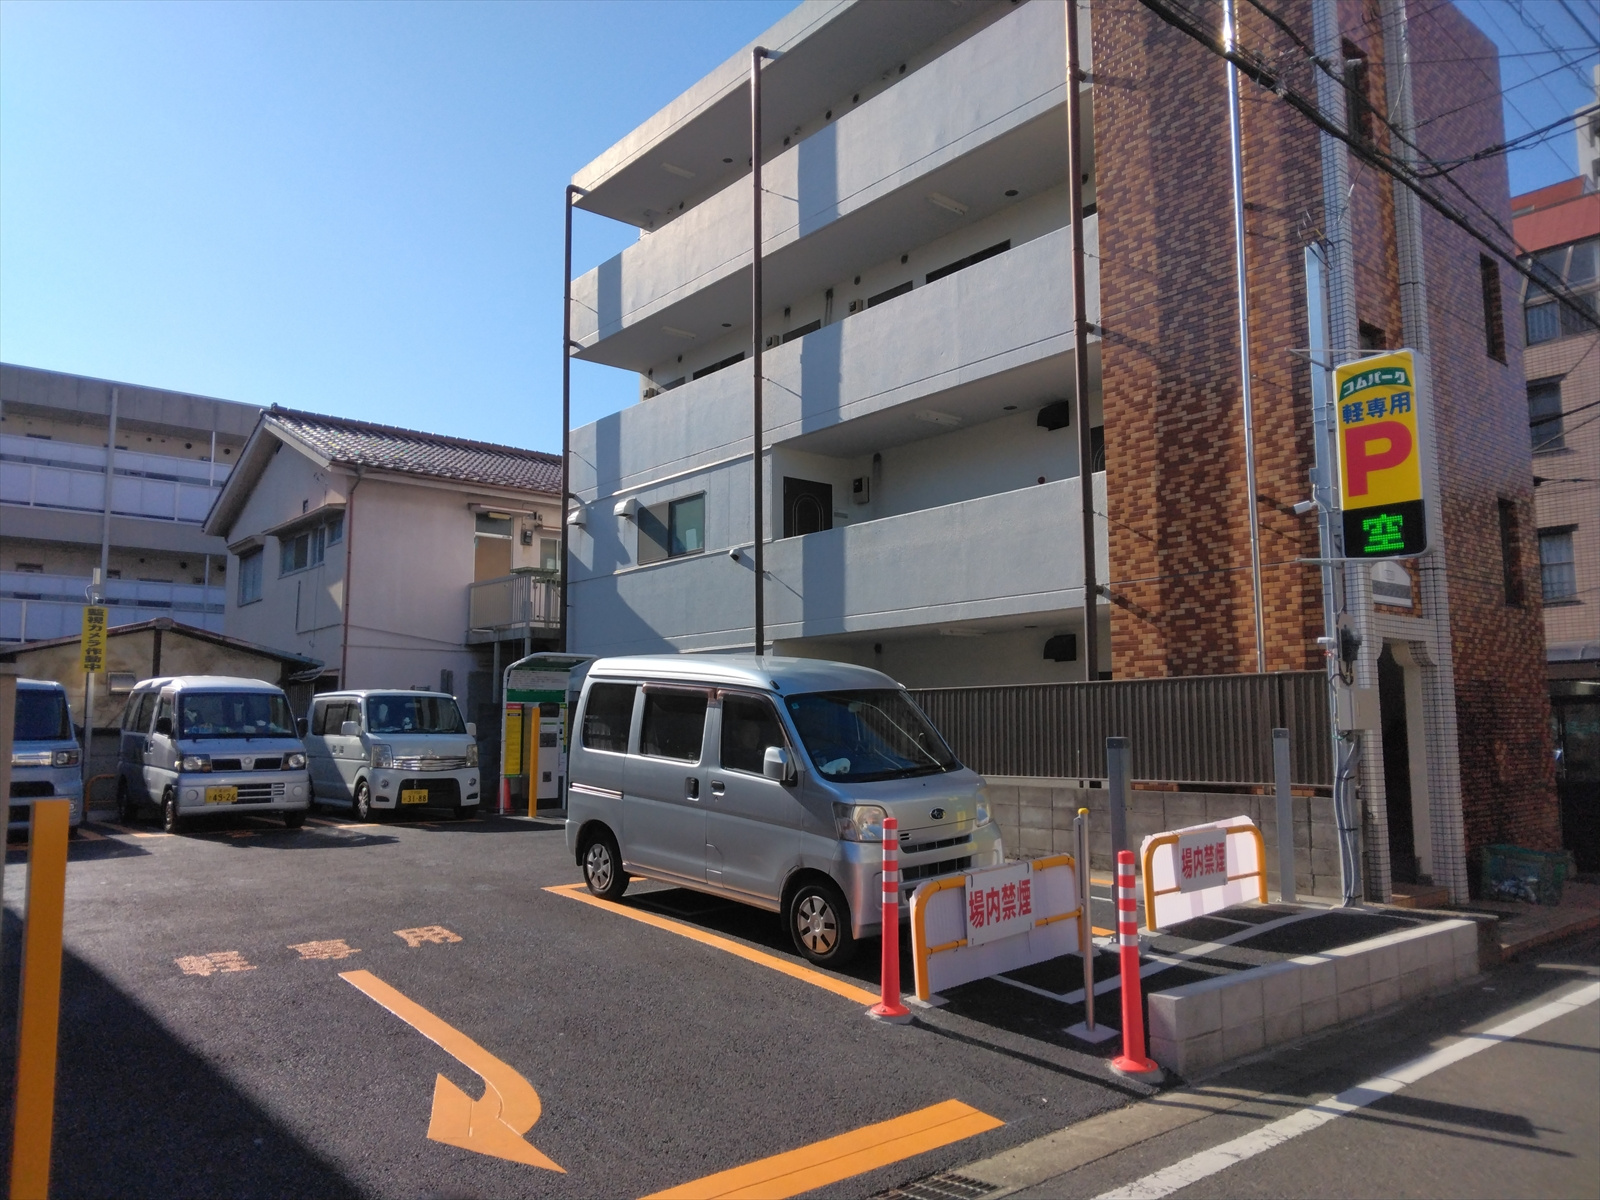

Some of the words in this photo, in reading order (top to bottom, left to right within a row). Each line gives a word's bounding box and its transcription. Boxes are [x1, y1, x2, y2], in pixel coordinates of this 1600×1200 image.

[1343, 370, 1406, 396] コムパーク
[1342, 391, 1411, 424] 軽専用
[1344, 420, 1412, 497] P
[1362, 513, 1405, 554] 空
[1181, 841, 1226, 880] 場内禁煙
[968, 878, 1032, 930] 場内禁煙
